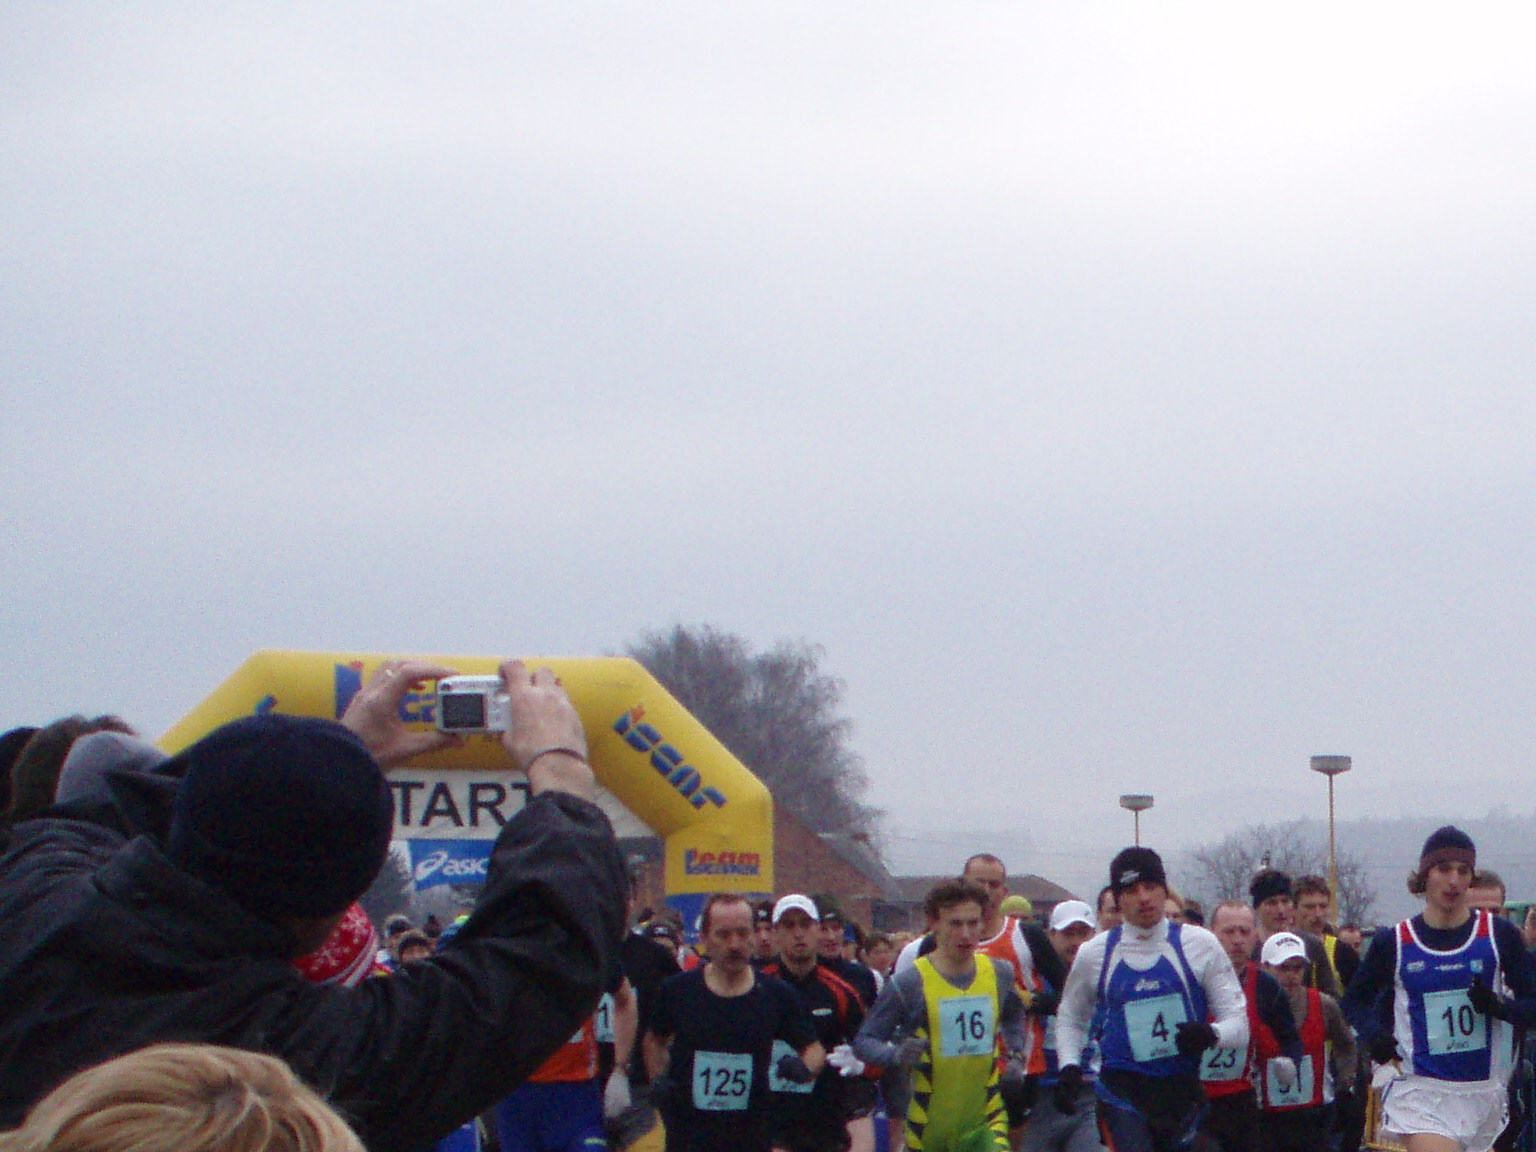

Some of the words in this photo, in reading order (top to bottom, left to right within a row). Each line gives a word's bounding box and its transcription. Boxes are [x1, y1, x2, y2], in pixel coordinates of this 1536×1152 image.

[387, 781, 533, 828] TAR
[955, 1010, 985, 1041] 16
[1152, 1011, 1169, 1042] 4
[1442, 1004, 1475, 1037] 10
[700, 1066, 747, 1096] 125
